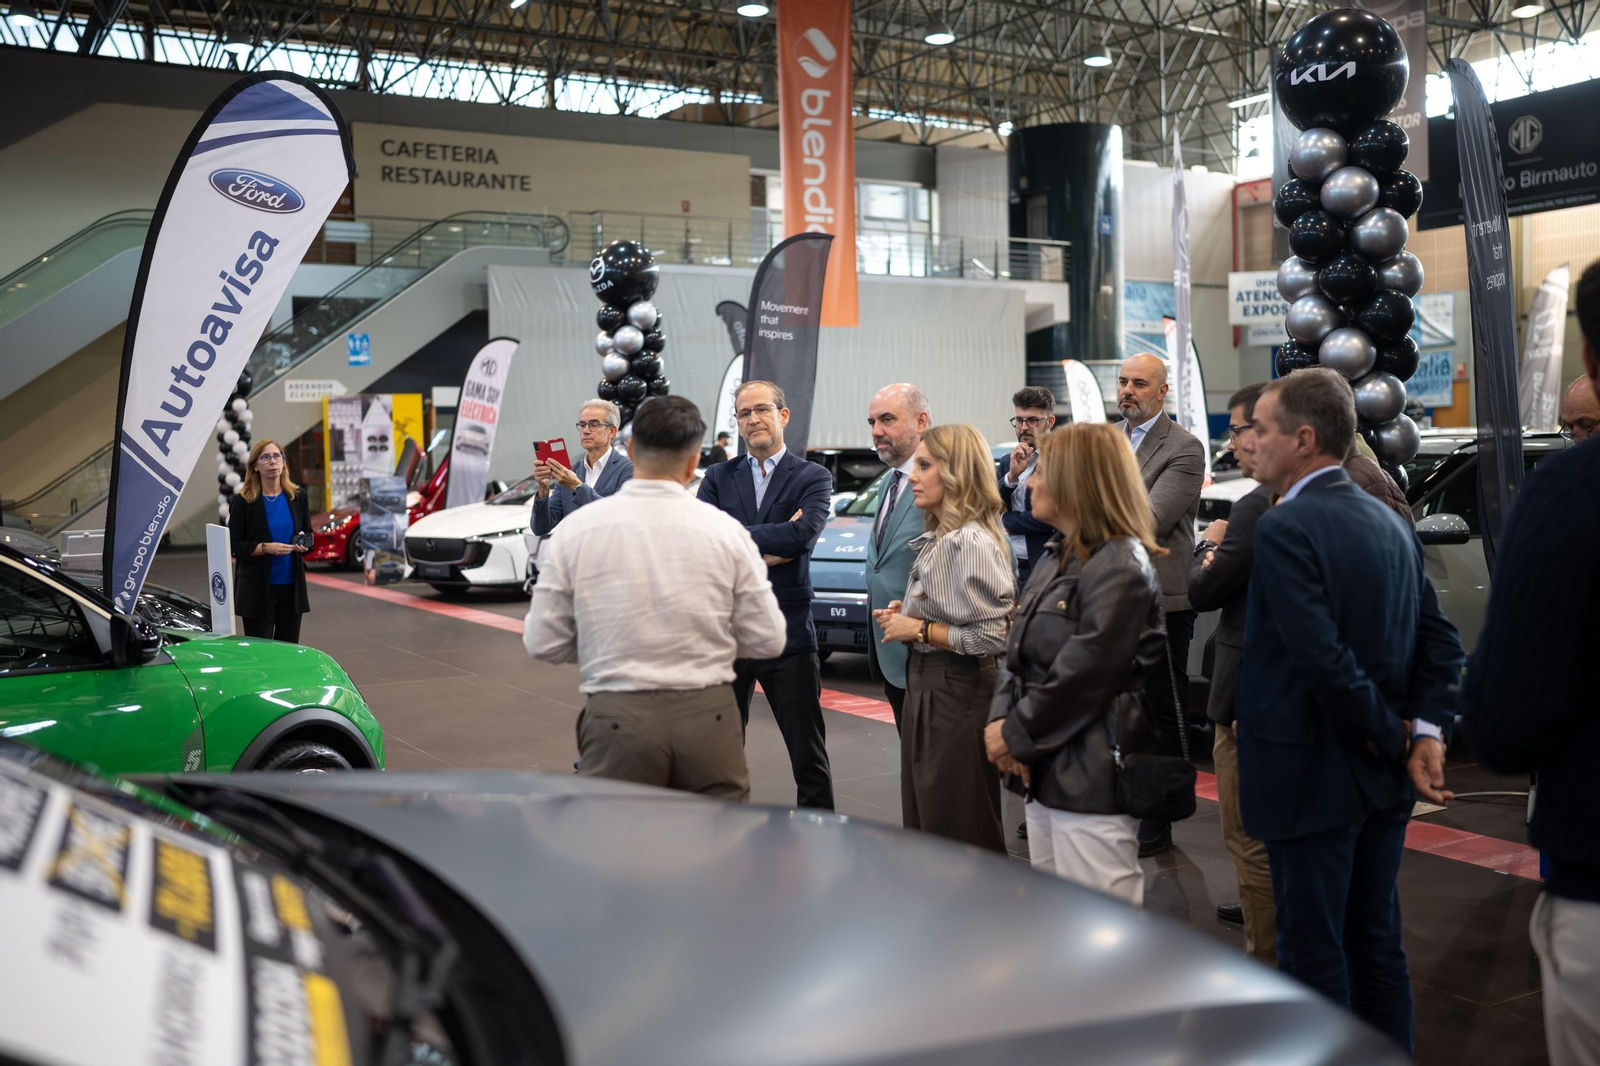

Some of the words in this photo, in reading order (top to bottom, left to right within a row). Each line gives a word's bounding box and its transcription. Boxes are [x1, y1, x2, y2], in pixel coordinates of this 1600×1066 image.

[1290, 61, 1357, 86] KIA
[1510, 118, 1541, 151] MG
[380, 139, 499, 165] CAFETERIA
[380, 165, 532, 192] RESTAURANTE
[1520, 161, 1598, 189] Birmauto
[594, 280, 615, 293] ZDA
[1256, 278, 1277, 287] OFIC
[1236, 290, 1282, 302] ATENC
[760, 300, 809, 315] Movement
[1242, 303, 1289, 317] EXPOS
[760, 314, 779, 325] that
[758, 328, 794, 341] inspires
[140, 230, 280, 457] Autoavisa
[465, 380, 487, 400] GAMA
[124, 546, 148, 591] grupo
[139, 495, 171, 546] blendio
[830, 607, 847, 617] EV3
